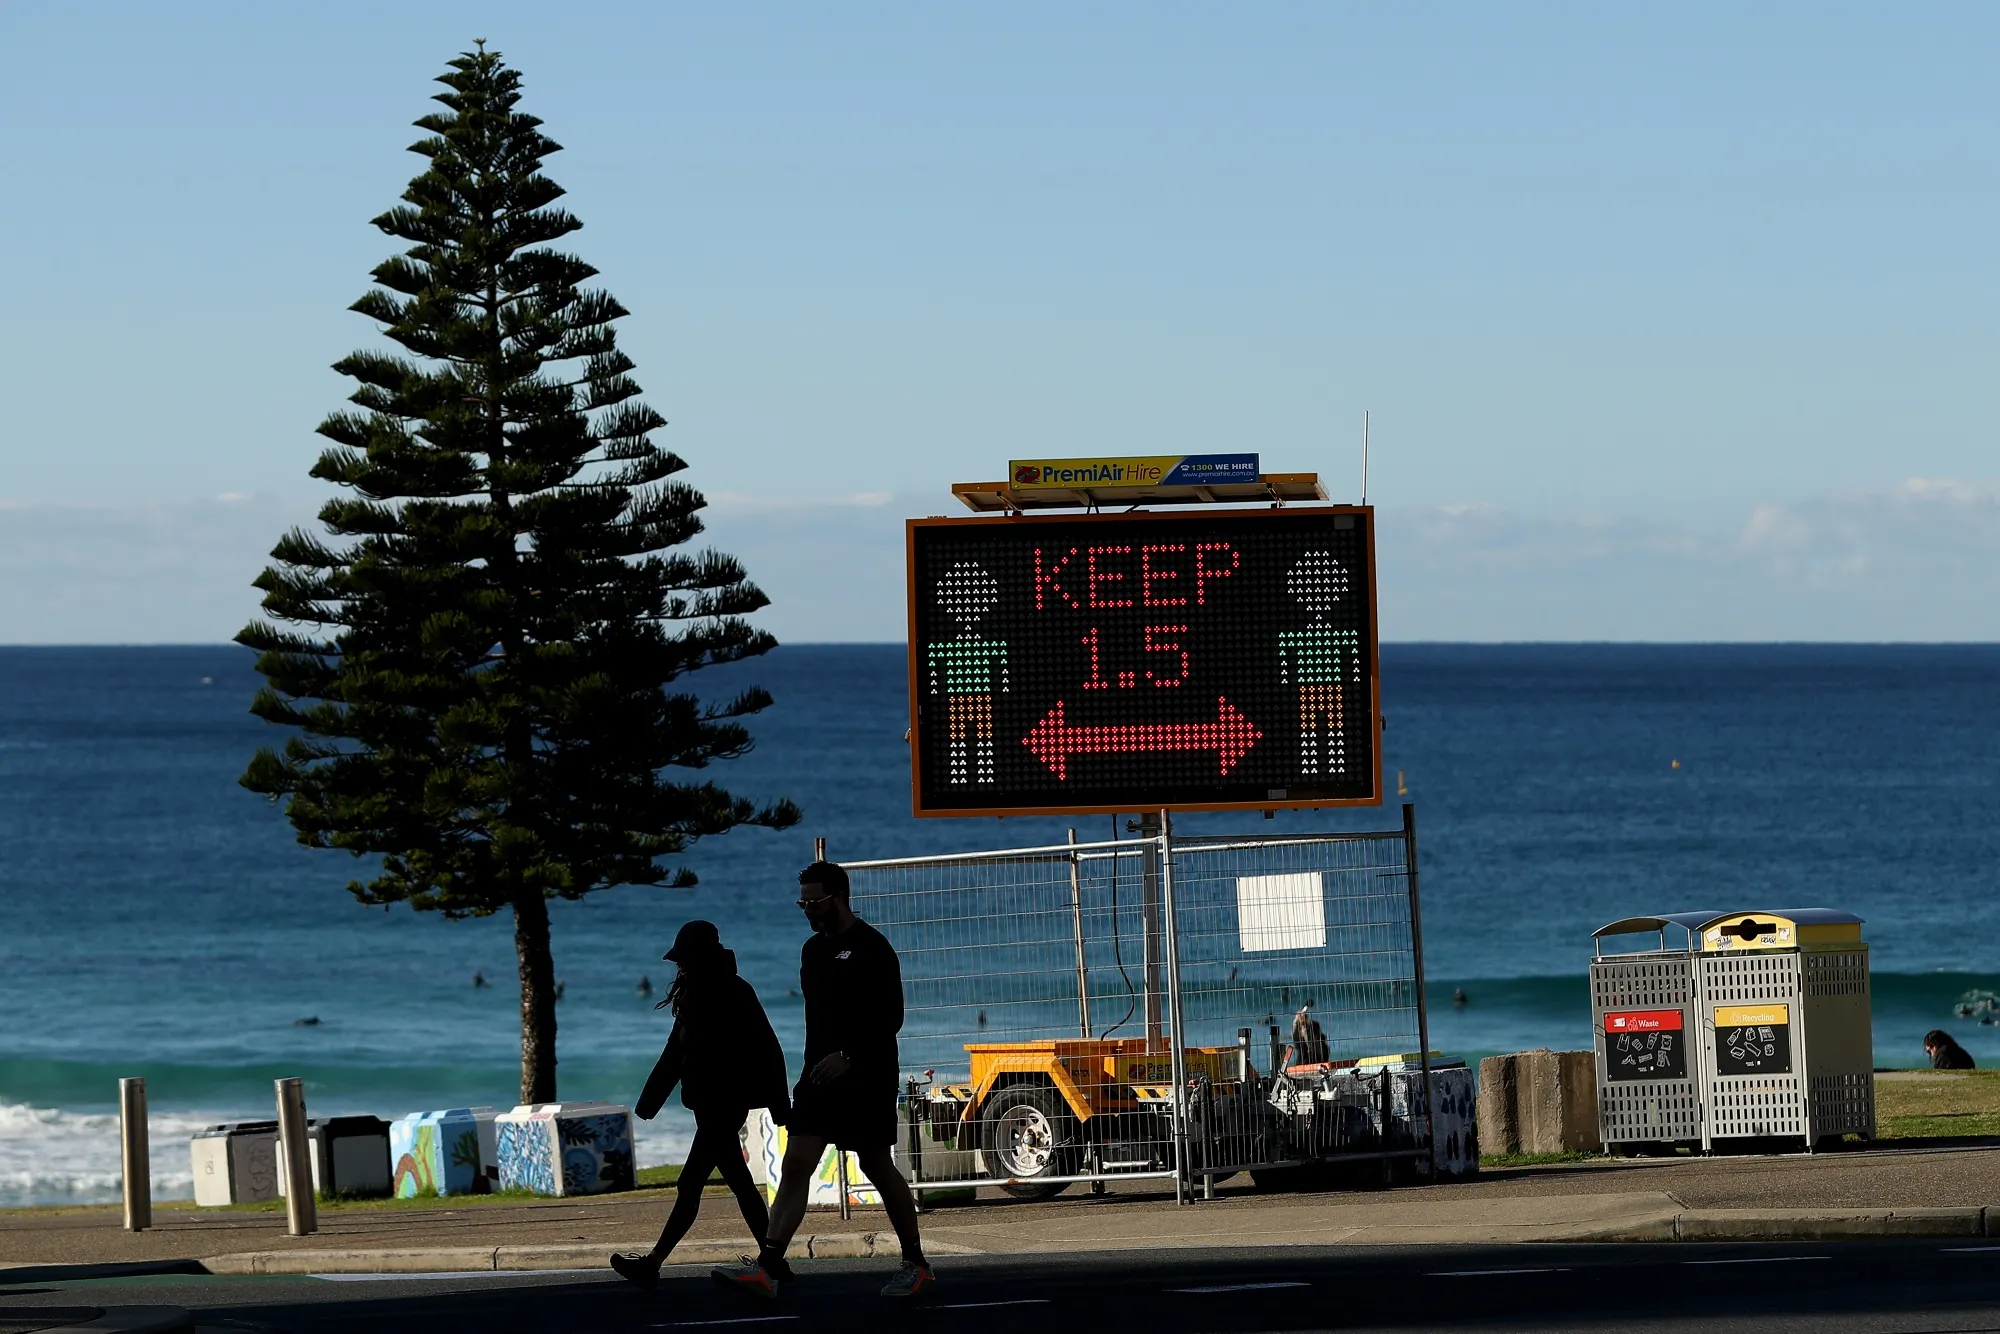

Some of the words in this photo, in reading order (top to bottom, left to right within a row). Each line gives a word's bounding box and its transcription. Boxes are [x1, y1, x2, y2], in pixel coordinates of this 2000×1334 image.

[1043, 464, 1124, 482] PremiAir
[1126, 464, 1161, 481] Hire
[1034, 542, 1240, 611] KEEP
[1082, 624, 1189, 690] 1.5
[1638, 1019, 1659, 1027] Waste
[1742, 1013, 1775, 1023] Recycling
